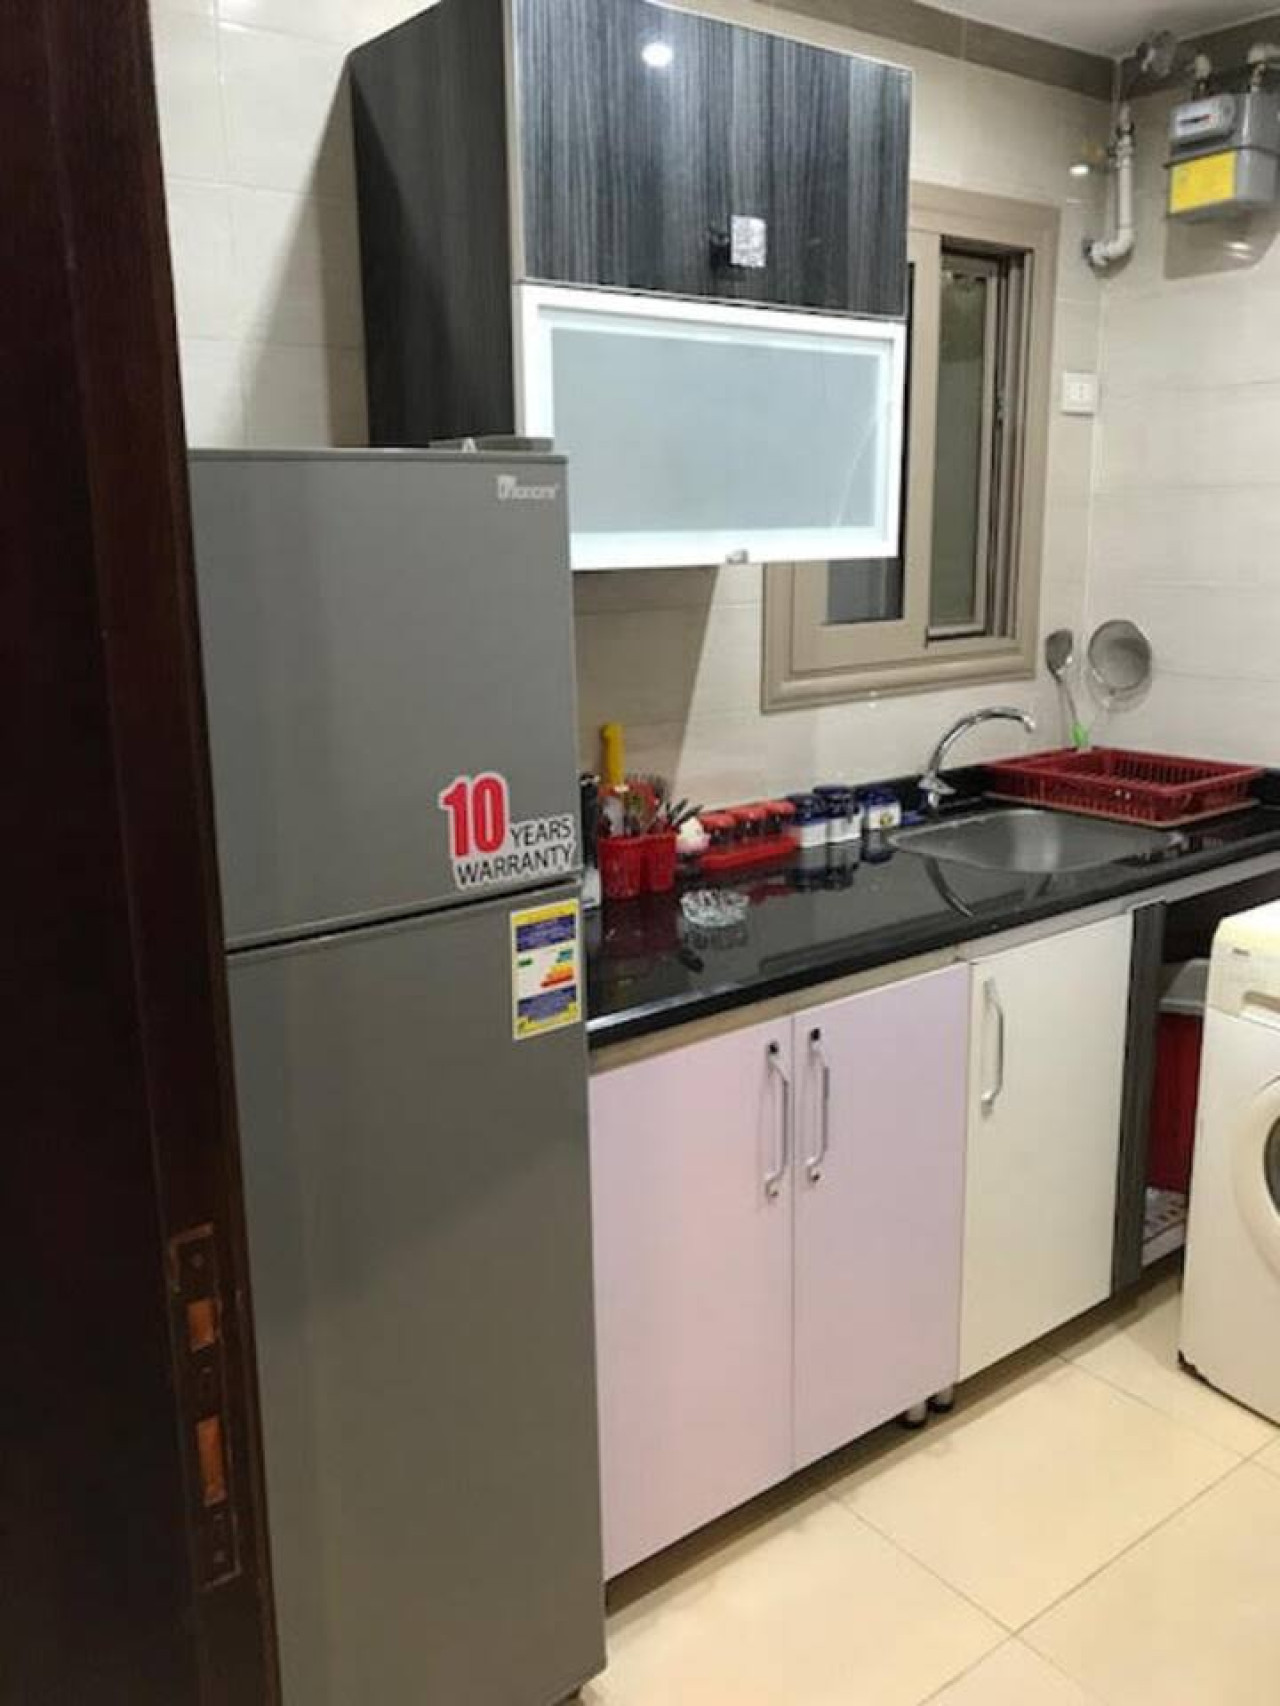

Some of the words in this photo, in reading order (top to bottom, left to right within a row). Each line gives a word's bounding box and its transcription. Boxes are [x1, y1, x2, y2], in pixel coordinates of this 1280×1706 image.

[442, 776, 505, 857] 10
[510, 817, 571, 848] YEARS
[457, 843, 573, 886] WARRANTY
